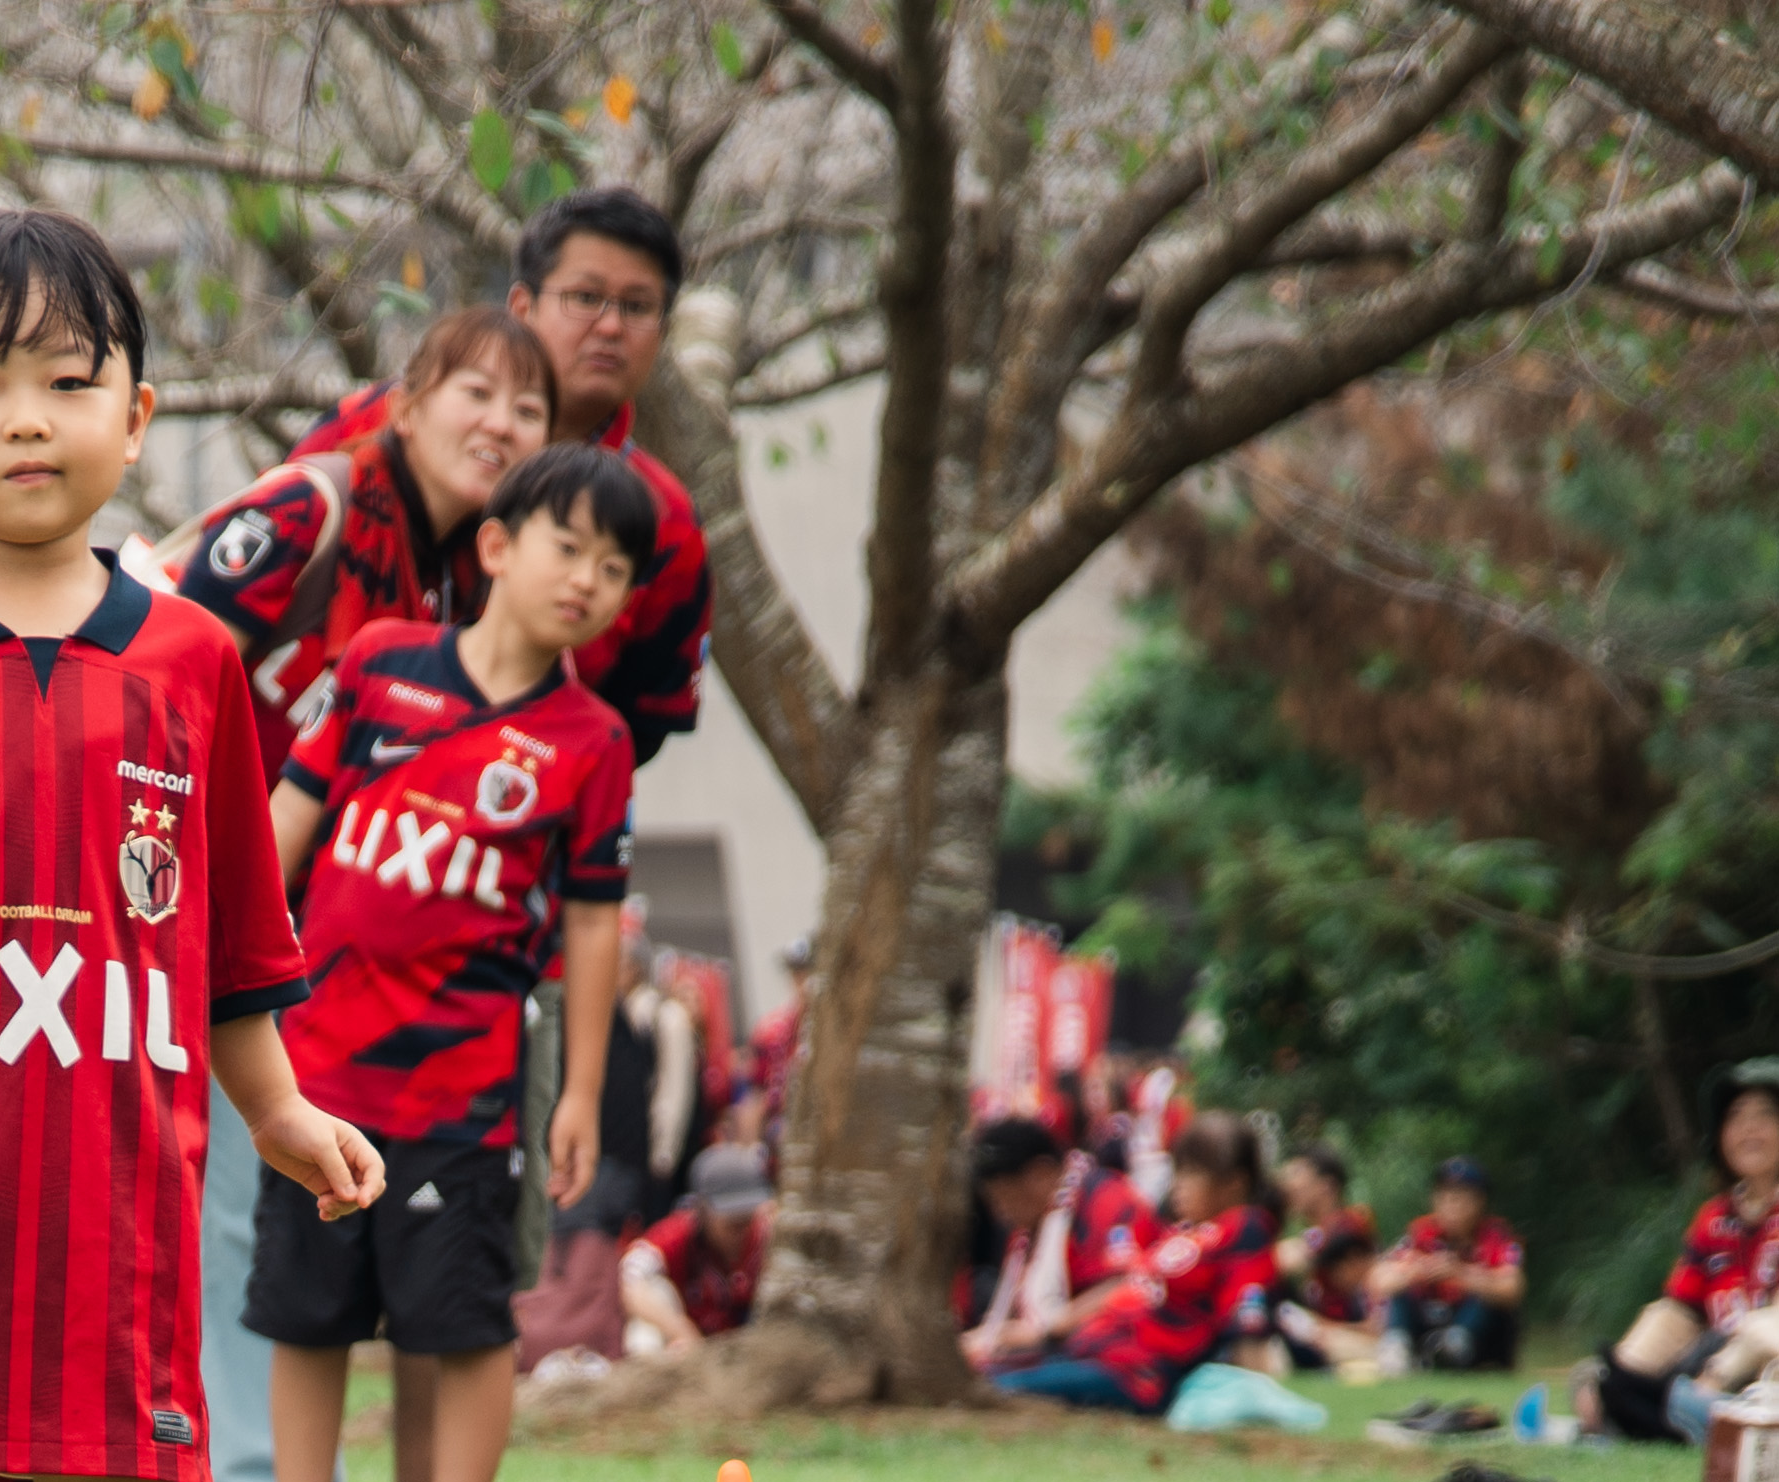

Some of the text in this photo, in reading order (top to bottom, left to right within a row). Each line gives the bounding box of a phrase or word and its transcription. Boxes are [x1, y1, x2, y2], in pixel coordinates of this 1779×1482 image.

[117, 760, 194, 795] mercari
[332, 801, 506, 910] LIXIL
[55, 907, 93, 924] DREAM
